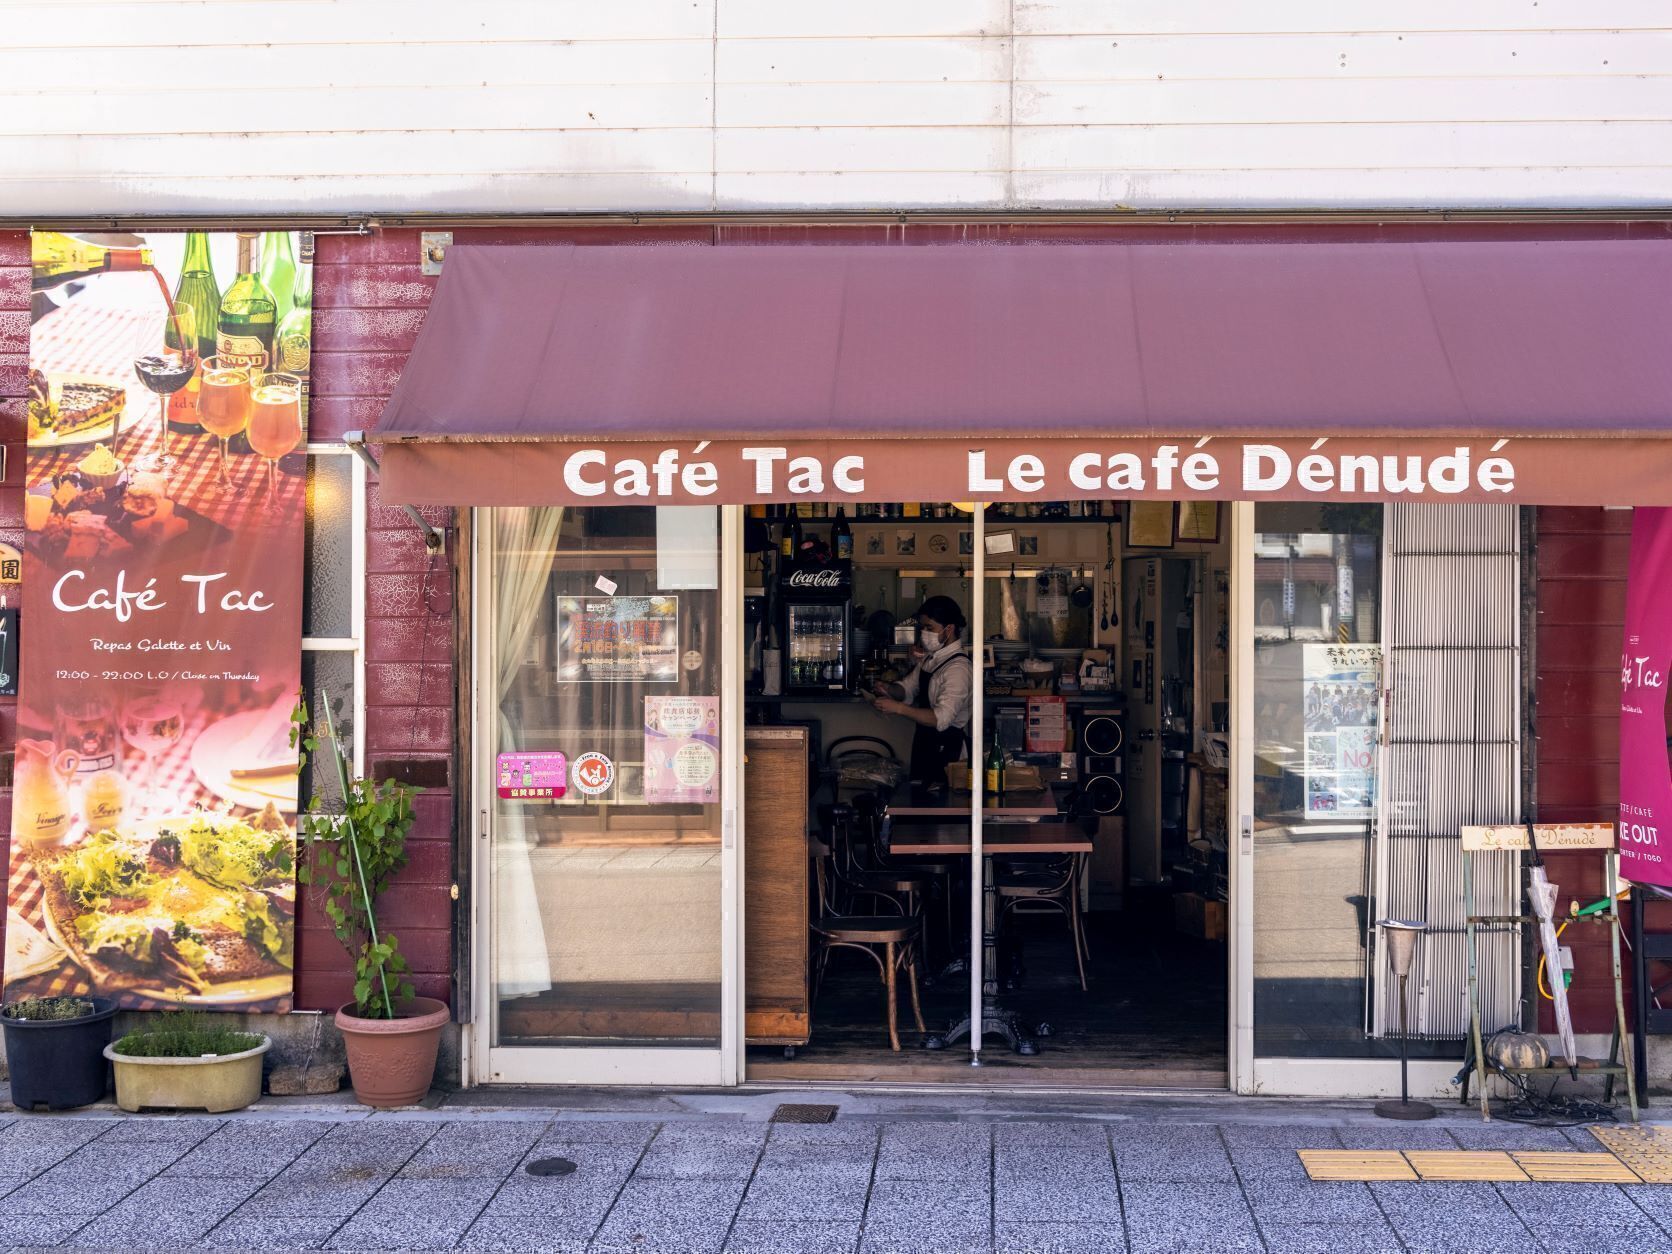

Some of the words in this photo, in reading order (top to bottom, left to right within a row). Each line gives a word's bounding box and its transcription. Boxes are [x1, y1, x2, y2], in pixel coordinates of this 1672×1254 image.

[563, 441, 718, 496] Café
[742, 447, 865, 494] Tac
[968, 448, 1045, 492] Le
[1068, 436, 1219, 491] café
[1242, 437, 1515, 493] Dénudé
[52, 569, 167, 622] Café
[181, 572, 274, 614] Tac
[89, 638, 132, 653] Repas
[137, 639, 187, 651] Galette
[189, 642, 202, 650] et
[206, 640, 232, 651] Vin
[56, 670, 90, 680] 12:00
[102, 671, 144, 680] 22:00
[181, 671, 207, 680] Close
[222, 672, 260, 682] Thursday
[1635, 656, 1662, 687] Tac
[1507, 830, 1531, 850] caf
[1541, 829, 1596, 846] Dénudé
[1631, 824, 1657, 846] OUT
